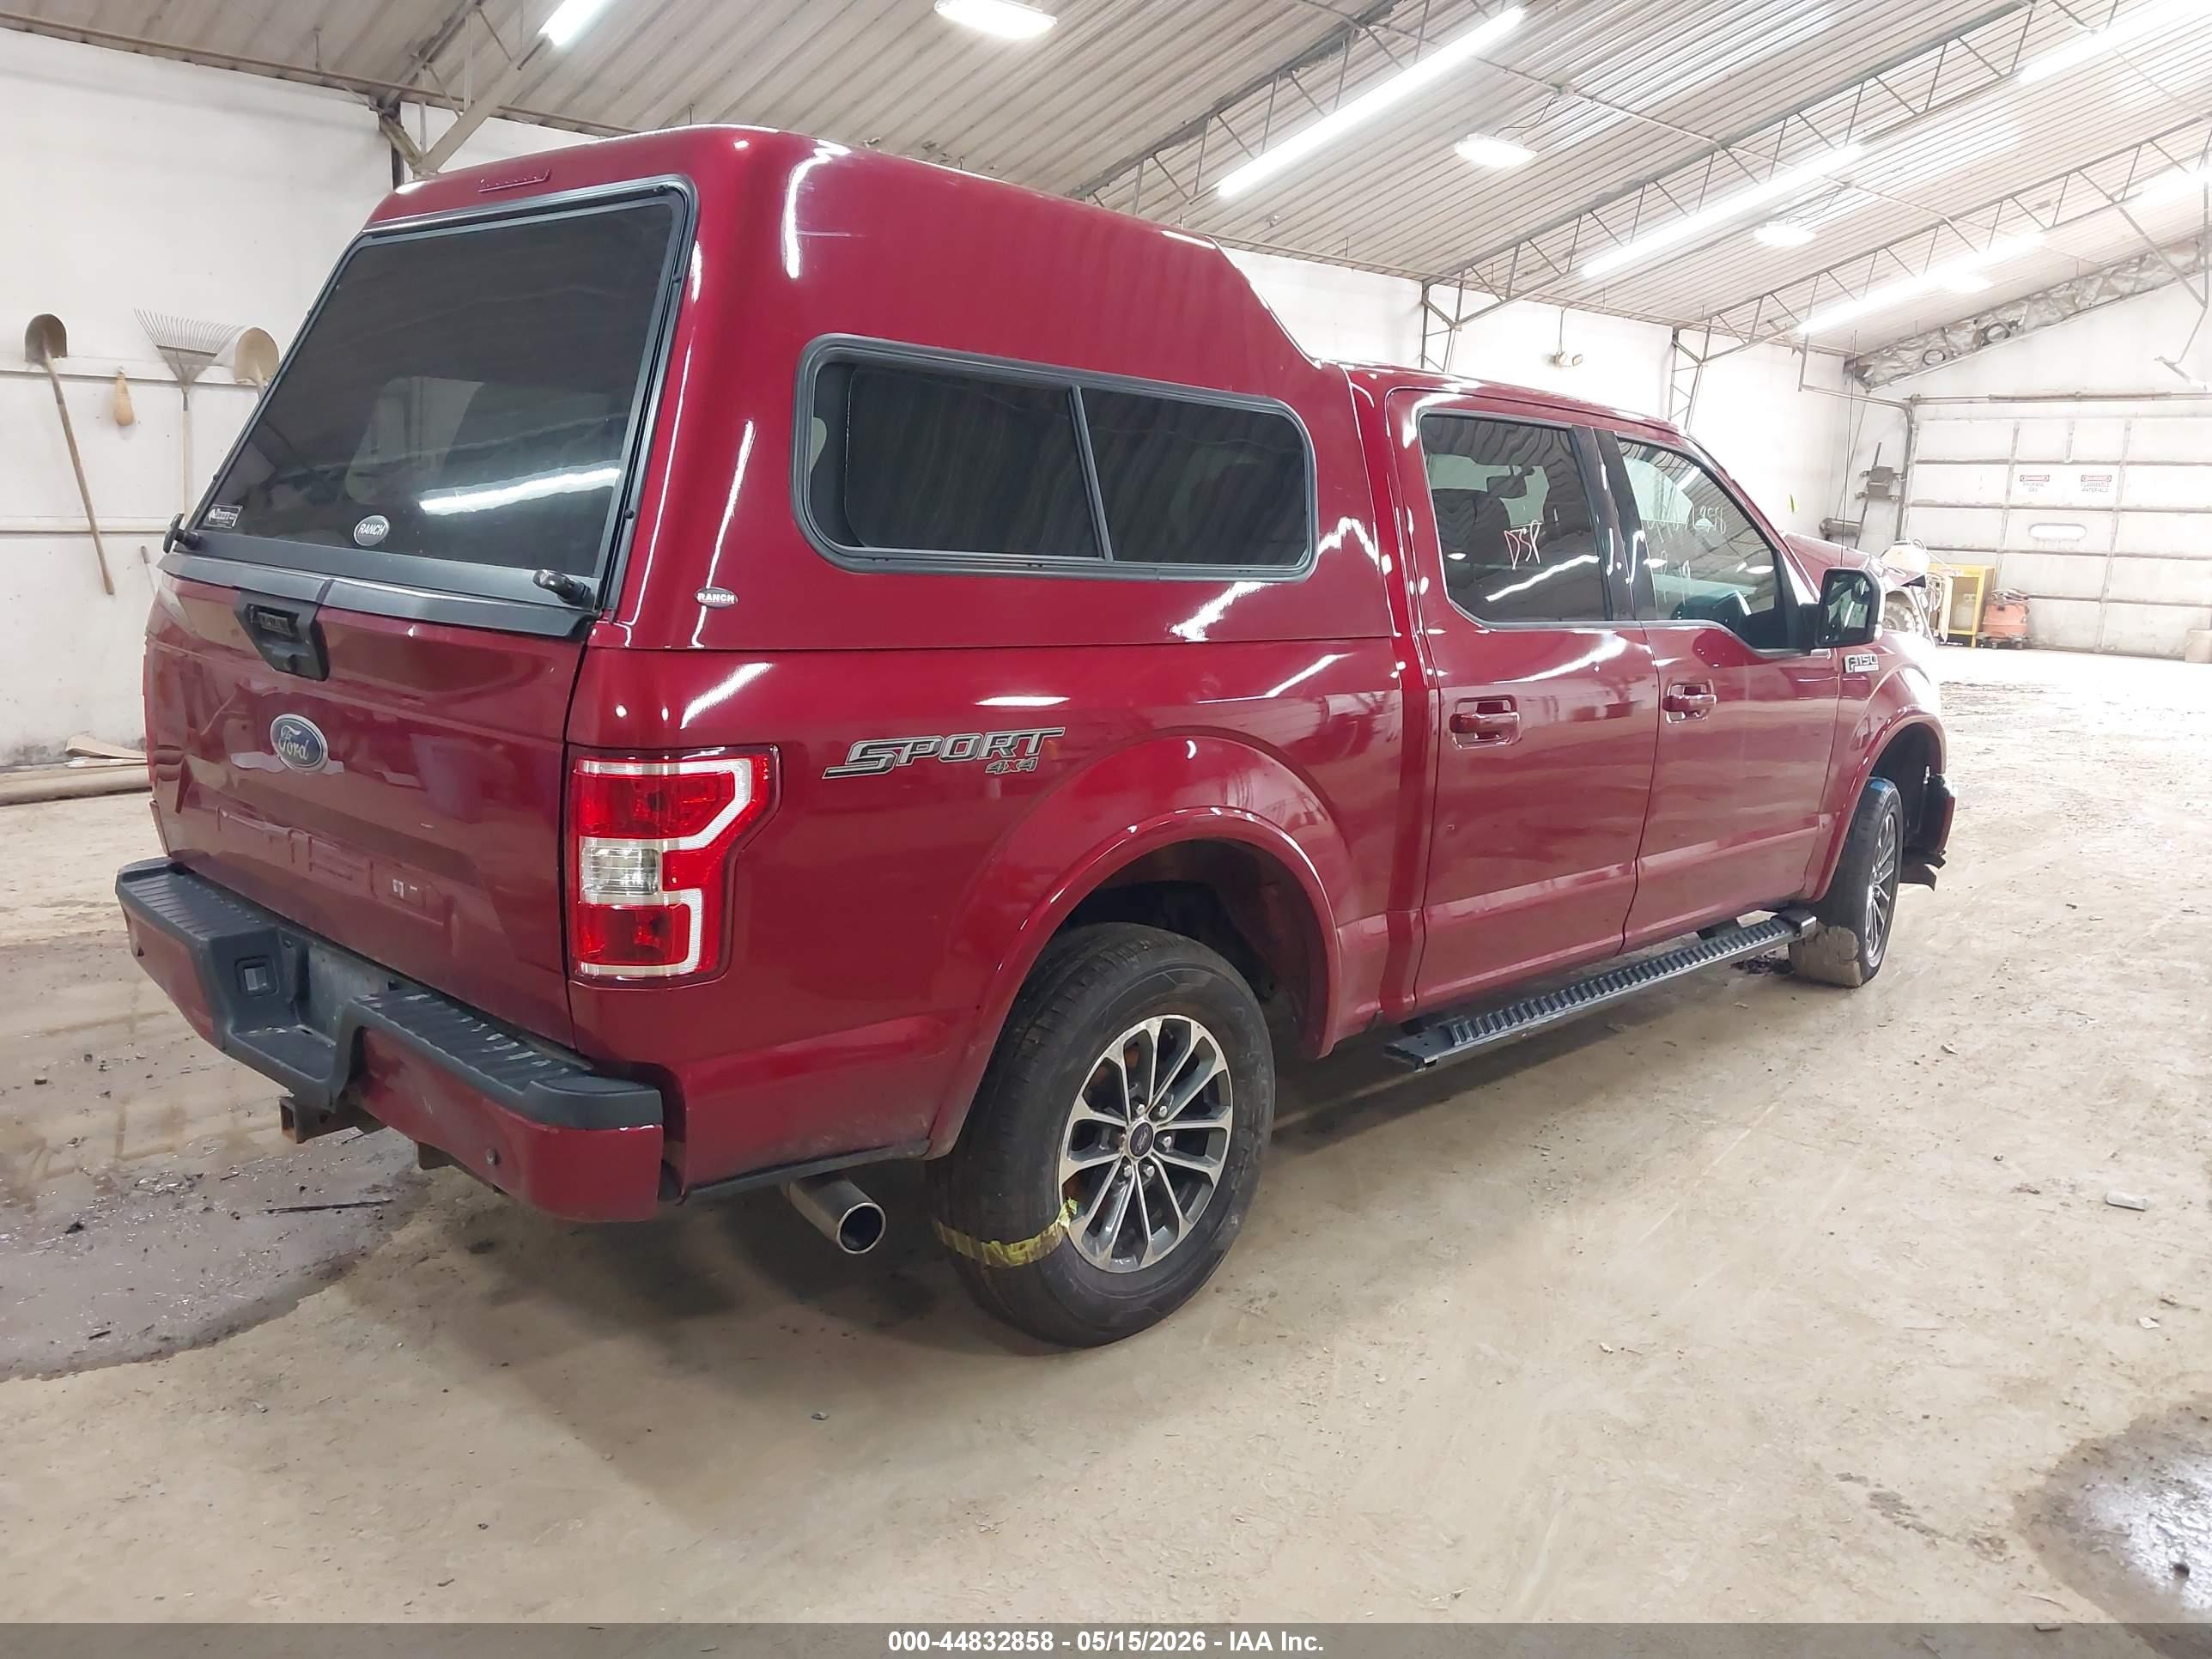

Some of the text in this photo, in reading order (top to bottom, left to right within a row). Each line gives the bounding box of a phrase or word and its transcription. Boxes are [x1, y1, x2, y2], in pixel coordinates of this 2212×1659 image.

[357, 523, 386, 536] RANCH
[696, 592, 735, 605] RANCH
[822, 726, 1066, 780] SPORT
